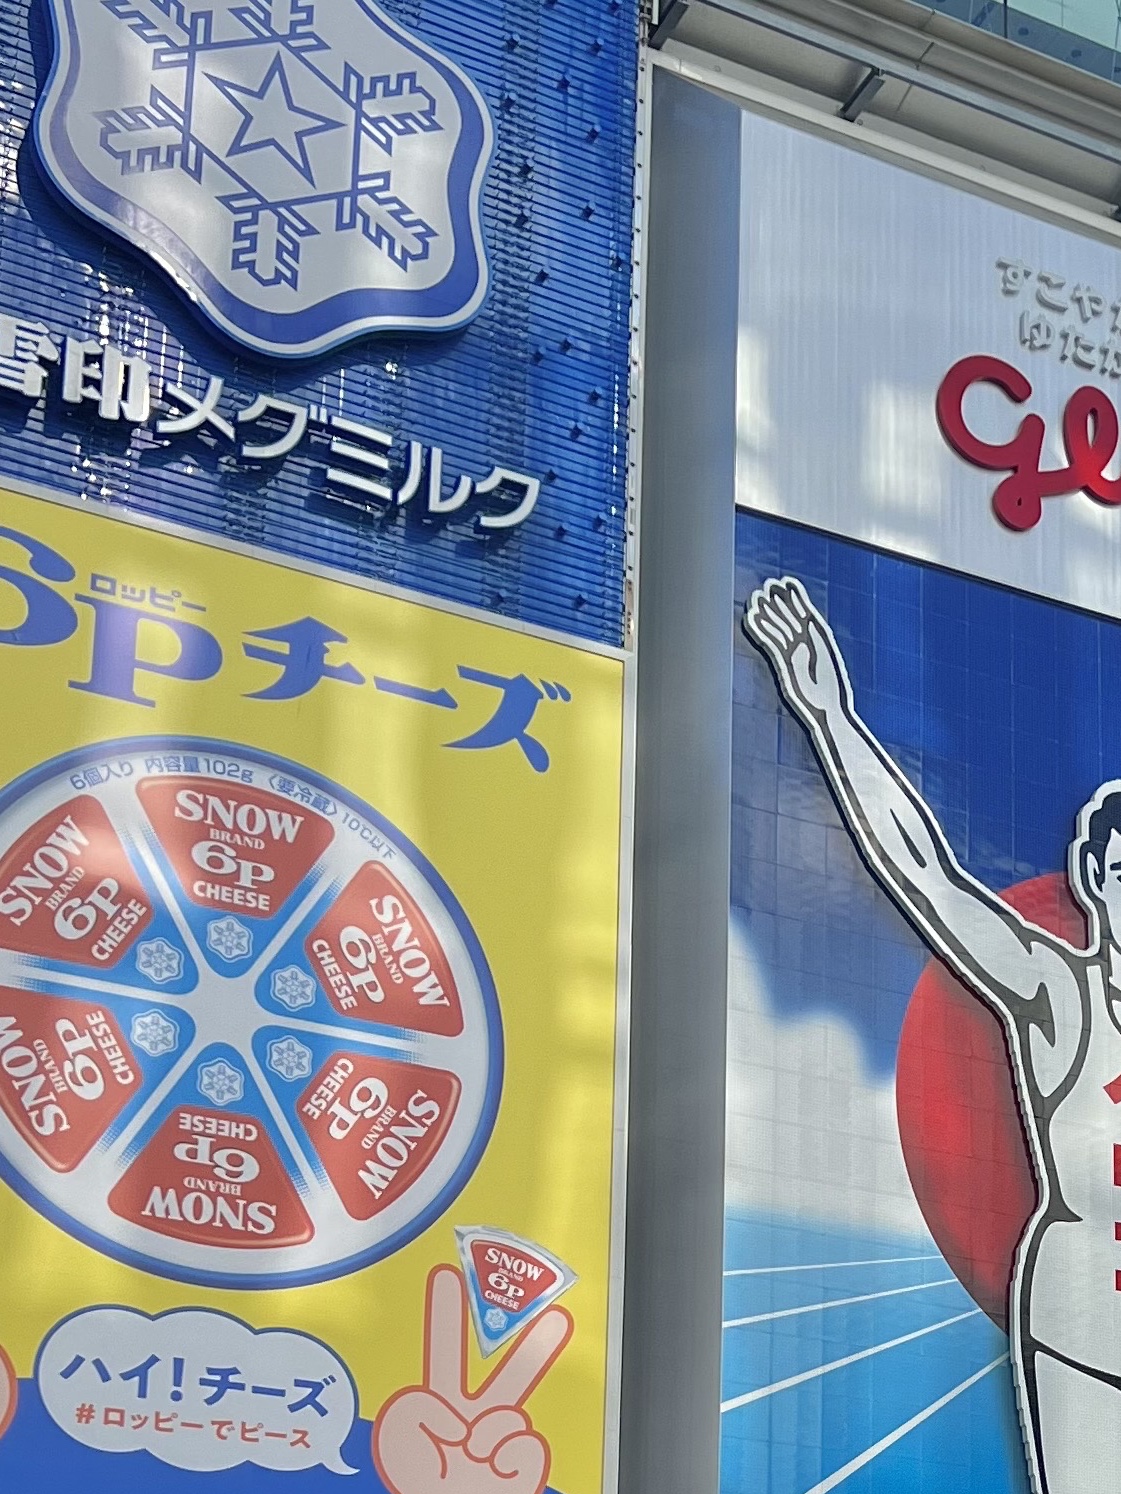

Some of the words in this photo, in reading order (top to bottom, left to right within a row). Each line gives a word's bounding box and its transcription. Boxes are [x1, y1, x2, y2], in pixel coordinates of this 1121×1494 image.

[91, 572, 206, 613] ロッピー
[70, 761, 134, 790] 6個入り
[175, 789, 304, 843] SNOW
[210, 828, 265, 850] BRAND
[0, 814, 90, 927] SNOW
[45, 866, 85, 912] BRAND
[191, 840, 275, 889] 6P
[54, 877, 121, 940] 6P
[193, 880, 271, 911] CHEESE
[92, 898, 146, 961] CHEESE
[369, 895, 450, 1007] SNOW
[312, 939, 358, 1010] CHEESE
[340, 925, 385, 1003] 6P
[372, 934, 403, 984] BRAND
[33, 1038, 68, 1093] BRAND
[55, 1018, 106, 1100] 6P
[86, 1010, 134, 1085] CHEESE
[0, 1016, 70, 1136] SNOW
[302, 1058, 354, 1120] CHEESE
[179, 1112, 258, 1141] CHEESE
[327, 1077, 389, 1139] 6P
[361, 1105, 397, 1149] BRAND
[173, 1134, 260, 1183] 6P
[358, 1089, 440, 1200] SNOW
[141, 1186, 277, 1235] SNOW
[183, 1176, 241, 1196] BRAND
[484, 1247, 544, 1281] SNOW
[487, 1272, 525, 1299] 6P
[484, 1289, 520, 1310] CHEESE
